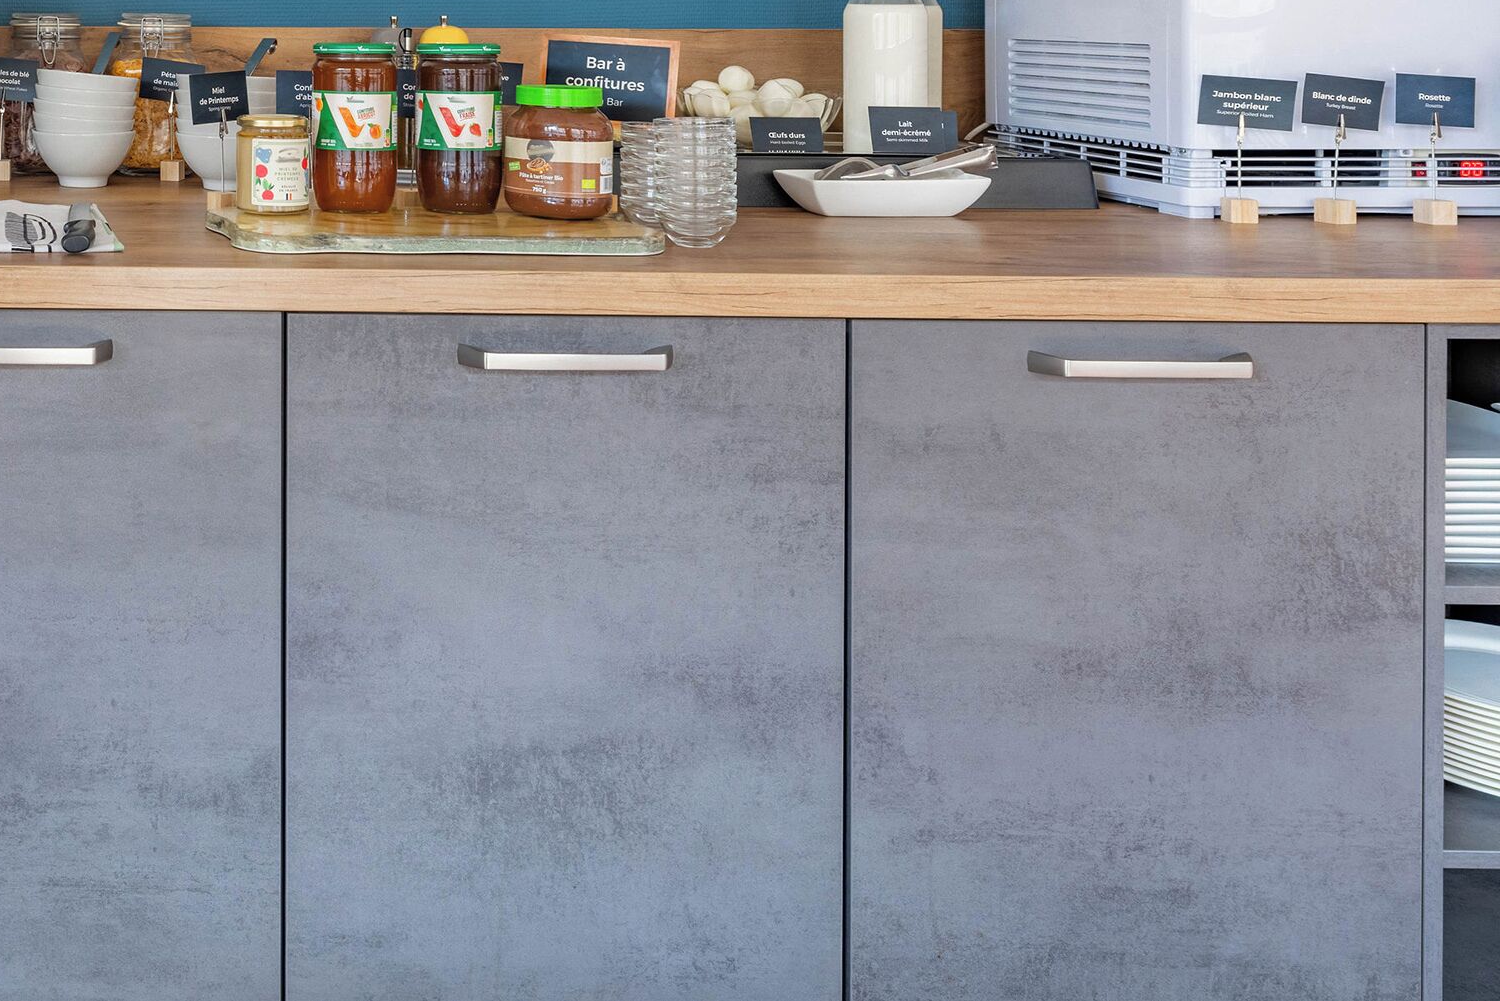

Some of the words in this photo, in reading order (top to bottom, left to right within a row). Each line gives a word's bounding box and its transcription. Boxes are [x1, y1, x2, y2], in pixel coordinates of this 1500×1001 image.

[586, 56, 613, 70] Bar
[616, 57, 626, 71] à
[160, 70, 176, 79] Péta
[565, 75, 645, 92] confitures
[212, 86, 225, 94] Miel
[208, 96, 239, 105] Printemps
[1212, 90, 1253, 100] Jambon
[1254, 93, 1282, 103] blanc
[1312, 91, 1335, 101] Blanc
[1335, 94, 1347, 102] de
[1347, 95, 1372, 105] dinde
[1418, 92, 1451, 102] Rosette
[606, 97, 624, 107] Bar
[1222, 101, 1269, 111] supérieur
[1216, 108, 1240, 116] Superior
[898, 120, 913, 128] Lait
[768, 131, 788, 139] Œufs
[881, 129, 932, 137] demi-écrémé
